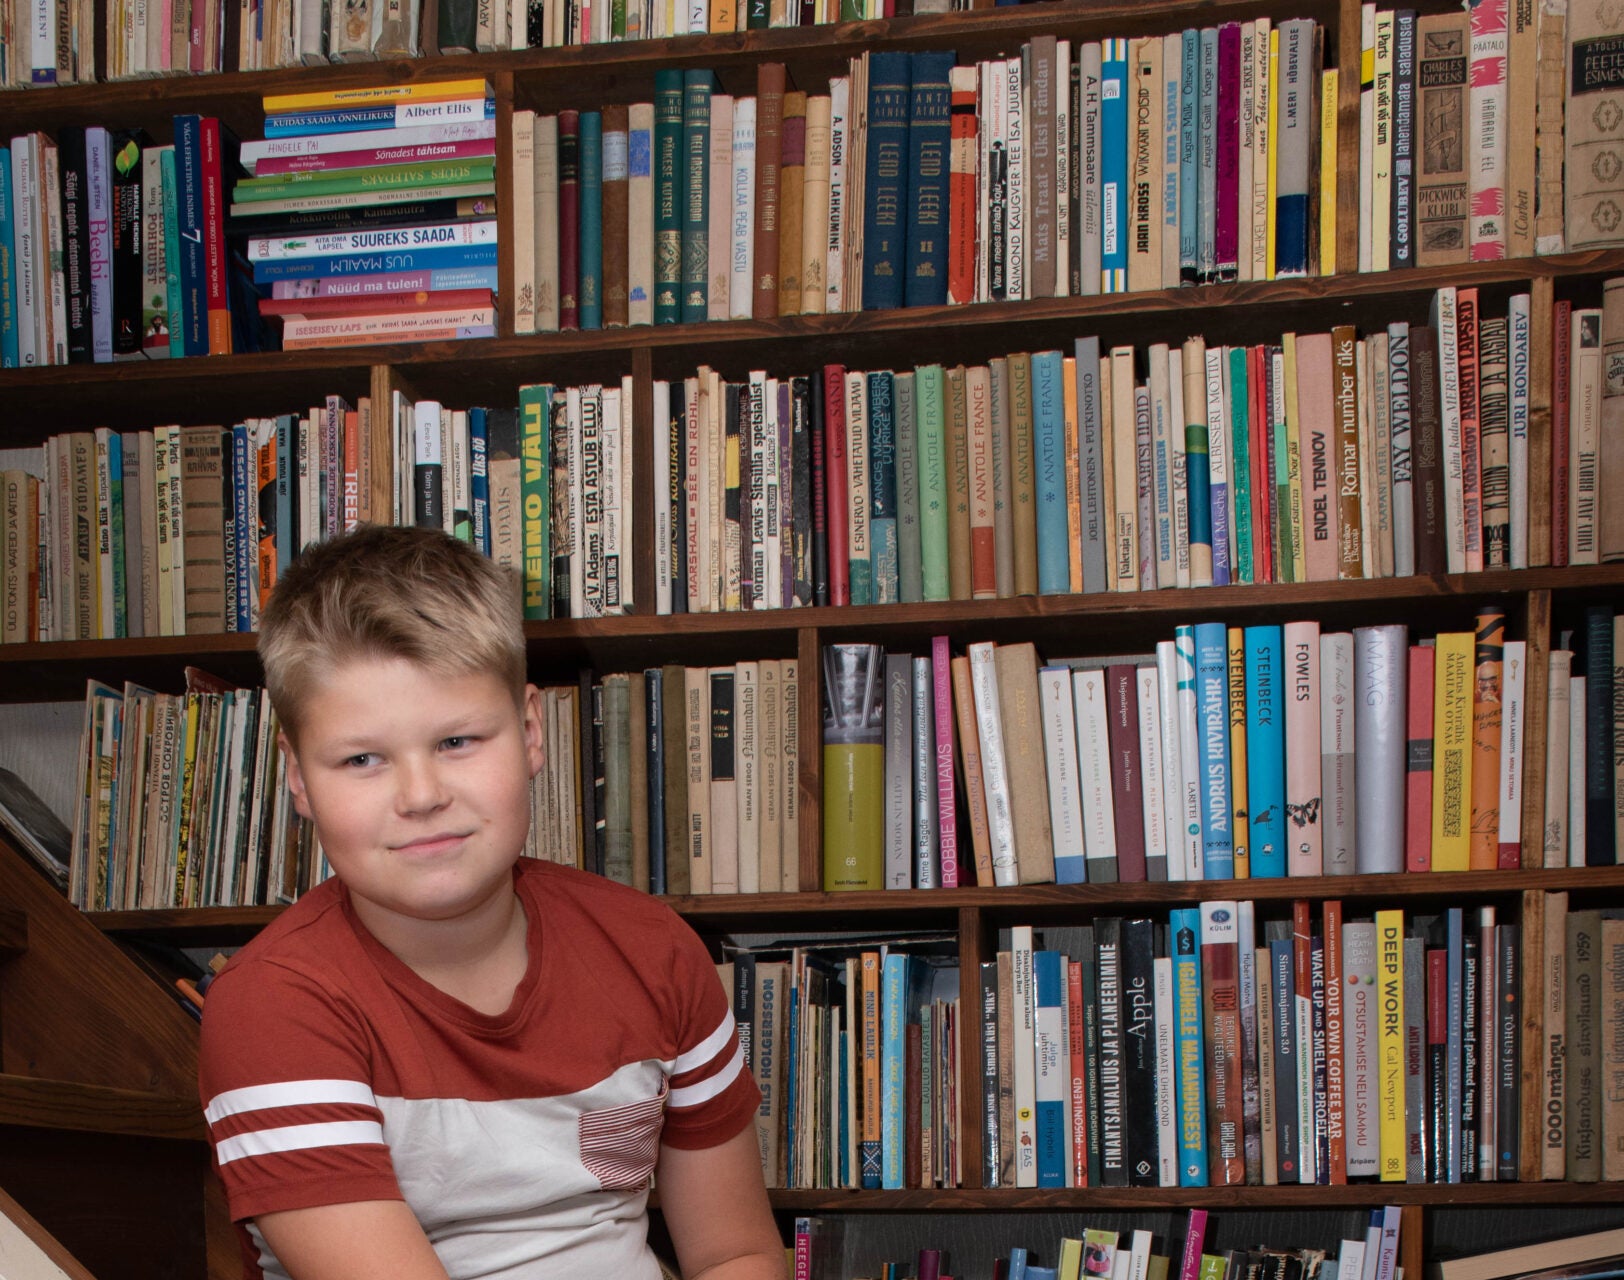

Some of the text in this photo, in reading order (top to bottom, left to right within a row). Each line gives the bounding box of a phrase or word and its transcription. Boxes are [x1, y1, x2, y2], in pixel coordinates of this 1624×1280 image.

[1034, 58, 1048, 116] rändan
[1423, 72, 1462, 85] DICKENS
[1424, 60, 1462, 73] CHARLES
[405, 105, 471, 118] Albert Ellis
[376, 145, 455, 159] Sõnadest tähtsam
[662, 136, 673, 219] PÄIKESE KUTSEL
[829, 116, 843, 252] A. ADSON LAHKUMINE
[876, 144, 899, 226] LEND LEEKI
[918, 142, 942, 224] LEND LEEKI
[1008, 67, 1021, 294] RAIMOND KAUGVER TEE ISA JUURDE
[1138, 88, 1150, 253] JAAN KROSS WIKMANI POISID
[1035, 173, 1048, 217] Traat
[1255, 182, 1266, 263] MIHKEL MUTT
[1427, 205, 1459, 217] KLUBI
[89, 219, 108, 279] Beebi
[330, 257, 382, 272] MAAILM
[351, 227, 455, 248] SUUREKS SAADA
[385, 255, 413, 268] UUS
[1036, 224, 1048, 261] Mats
[327, 278, 422, 294] Nüüd ma tulen!
[829, 372, 842, 416] SAND
[1390, 334, 1411, 483] FAY WELDON
[1514, 312, 1528, 438] JURI BONDAREV
[688, 446, 697, 467] ON
[925, 372, 938, 491] ANATOLE FRANCE
[953, 374, 967, 493] ANATOLE FRANCE
[1084, 373, 1098, 542] JOEL LEHTONEN PUTKINOTKO
[1337, 340, 1357, 498] Roimar number üks
[522, 403, 542, 607] HEINO VÄLI
[584, 402, 598, 595] V. Adams ESTA ASTUB ELLU
[688, 473, 697, 501] SEE
[750, 383, 765, 601] Norman Lewis Sitsiilia spetsialist
[1173, 450, 1186, 490] KAEV
[1312, 431, 1328, 541] ENDEL TENNOV
[225, 520, 236, 631] RAIMOND KAUGVER
[688, 521, 697, 597] MARSHALL
[1120, 537, 1132, 575] Valetaja
[745, 671, 751, 681] 1
[766, 672, 773, 681] 3
[787, 667, 795, 678] 2
[1230, 648, 1246, 727] STEINBECK
[1257, 647, 1272, 726] STEINBECK
[1296, 643, 1310, 701] FOWLES
[1445, 653, 1455, 745] MAAILMA OTSAS
[1455, 653, 1467, 745] Andrus Kivirähk
[1202, 678, 1228, 832] ANDRUS KIVIRÄHK
[938, 744, 956, 883] ROBBIE WILLIAMS
[1127, 977, 1152, 1039] Apple
[1279, 954, 1290, 1054] Sinine majandus 3.0
[1384, 927, 1399, 1121] DEEP WORK Cal Newport
[1462, 958, 1476, 1028] finantsturud
[759, 979, 774, 1116] NILS HOLGERSSON
[1040, 1032, 1050, 1076] juhtimine
[1099, 944, 1122, 1168] FINANTSANALÜÜS JA PLANEERIMINE
[1178, 961, 1202, 1151] IGAÜHELE MAJANDUSEST
[1311, 949, 1327, 1137] WAKE UP SMELL PROFIT
[1327, 977, 1342, 1139] YOUR OWN COFFEE BAR
[1355, 990, 1368, 1147] OTSUSTAMISE NELI SAMMU
[1463, 1045, 1477, 1086] pangad
[1503, 1058, 1514, 1089] JUHT
[1463, 1089, 1476, 1121] Raha,
[1547, 1034, 1565, 1149] 1000 mängu
[1023, 1148, 1032, 1167] EAS
